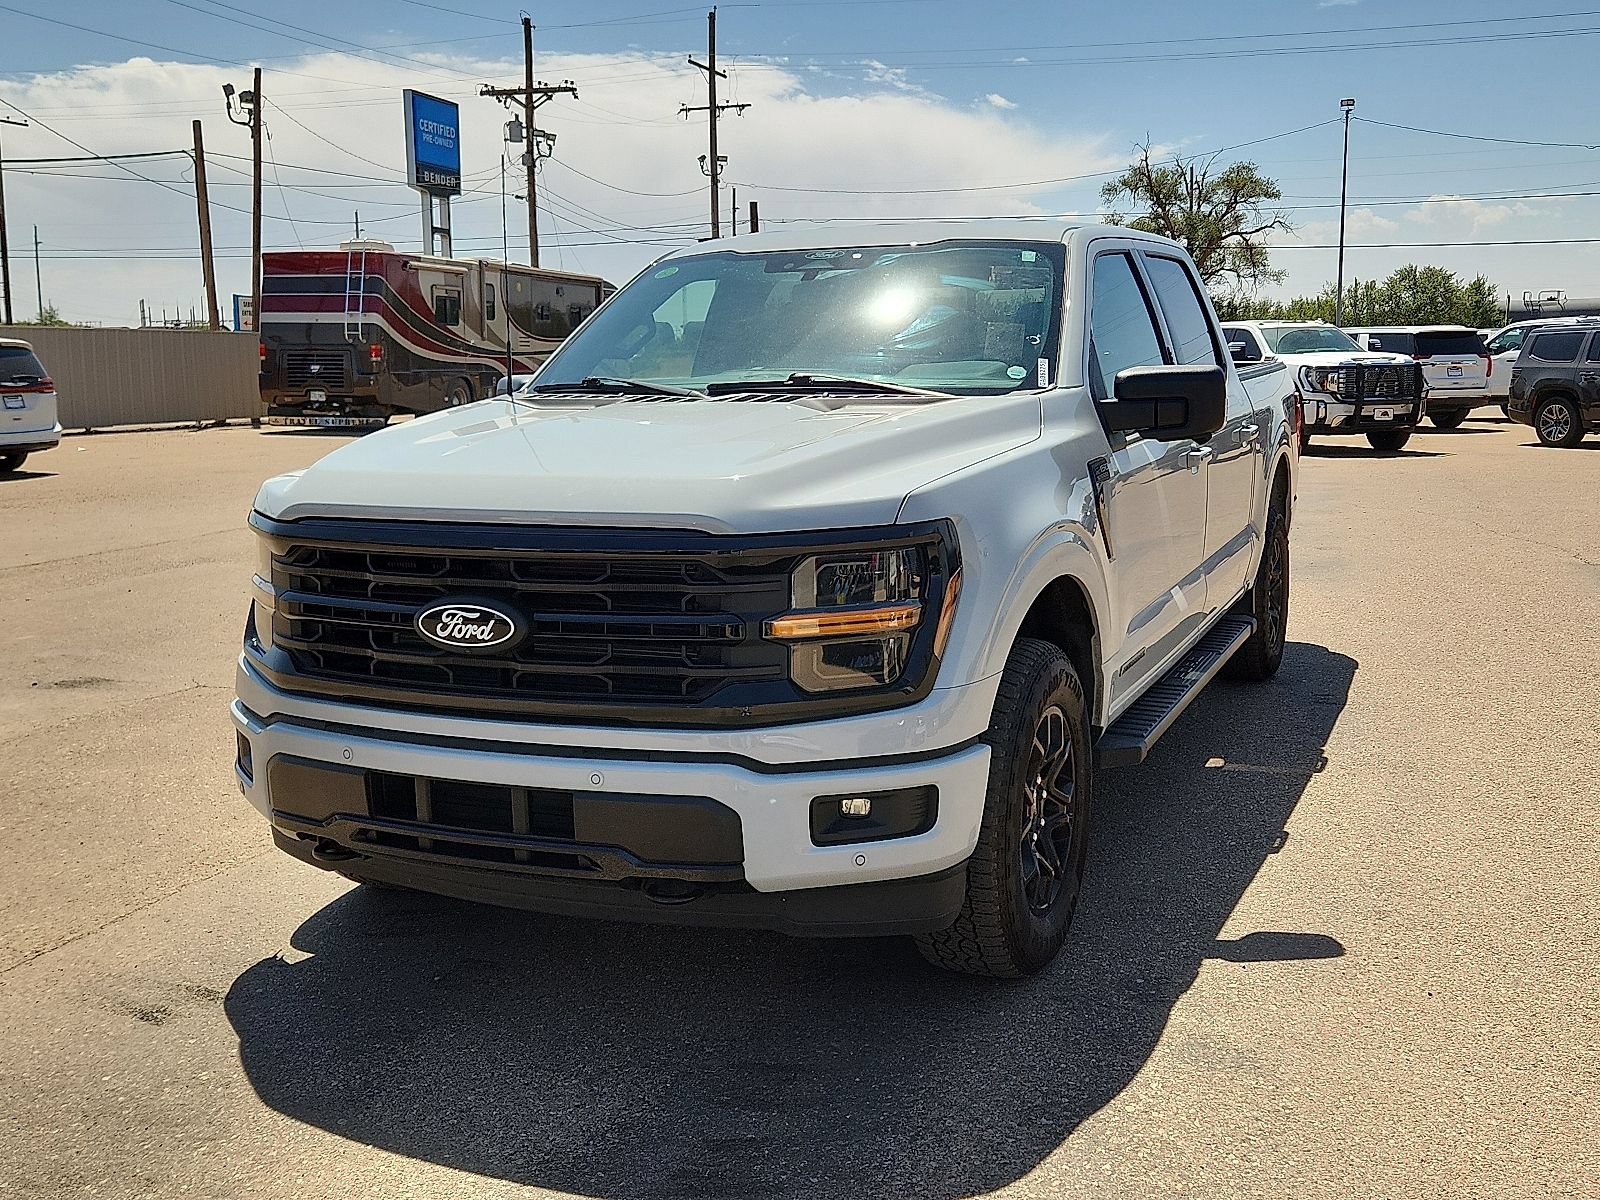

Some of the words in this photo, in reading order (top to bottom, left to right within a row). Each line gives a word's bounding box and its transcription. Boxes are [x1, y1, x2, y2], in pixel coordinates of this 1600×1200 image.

[419, 119, 456, 138] CERTIFIED
[422, 133, 454, 149] PRE-OWNED
[424, 171, 456, 187] BENDER
[284, 416, 319, 426] TRAVEL
[324, 416, 370, 426] SUPREME
[436, 609, 495, 641] Ford
